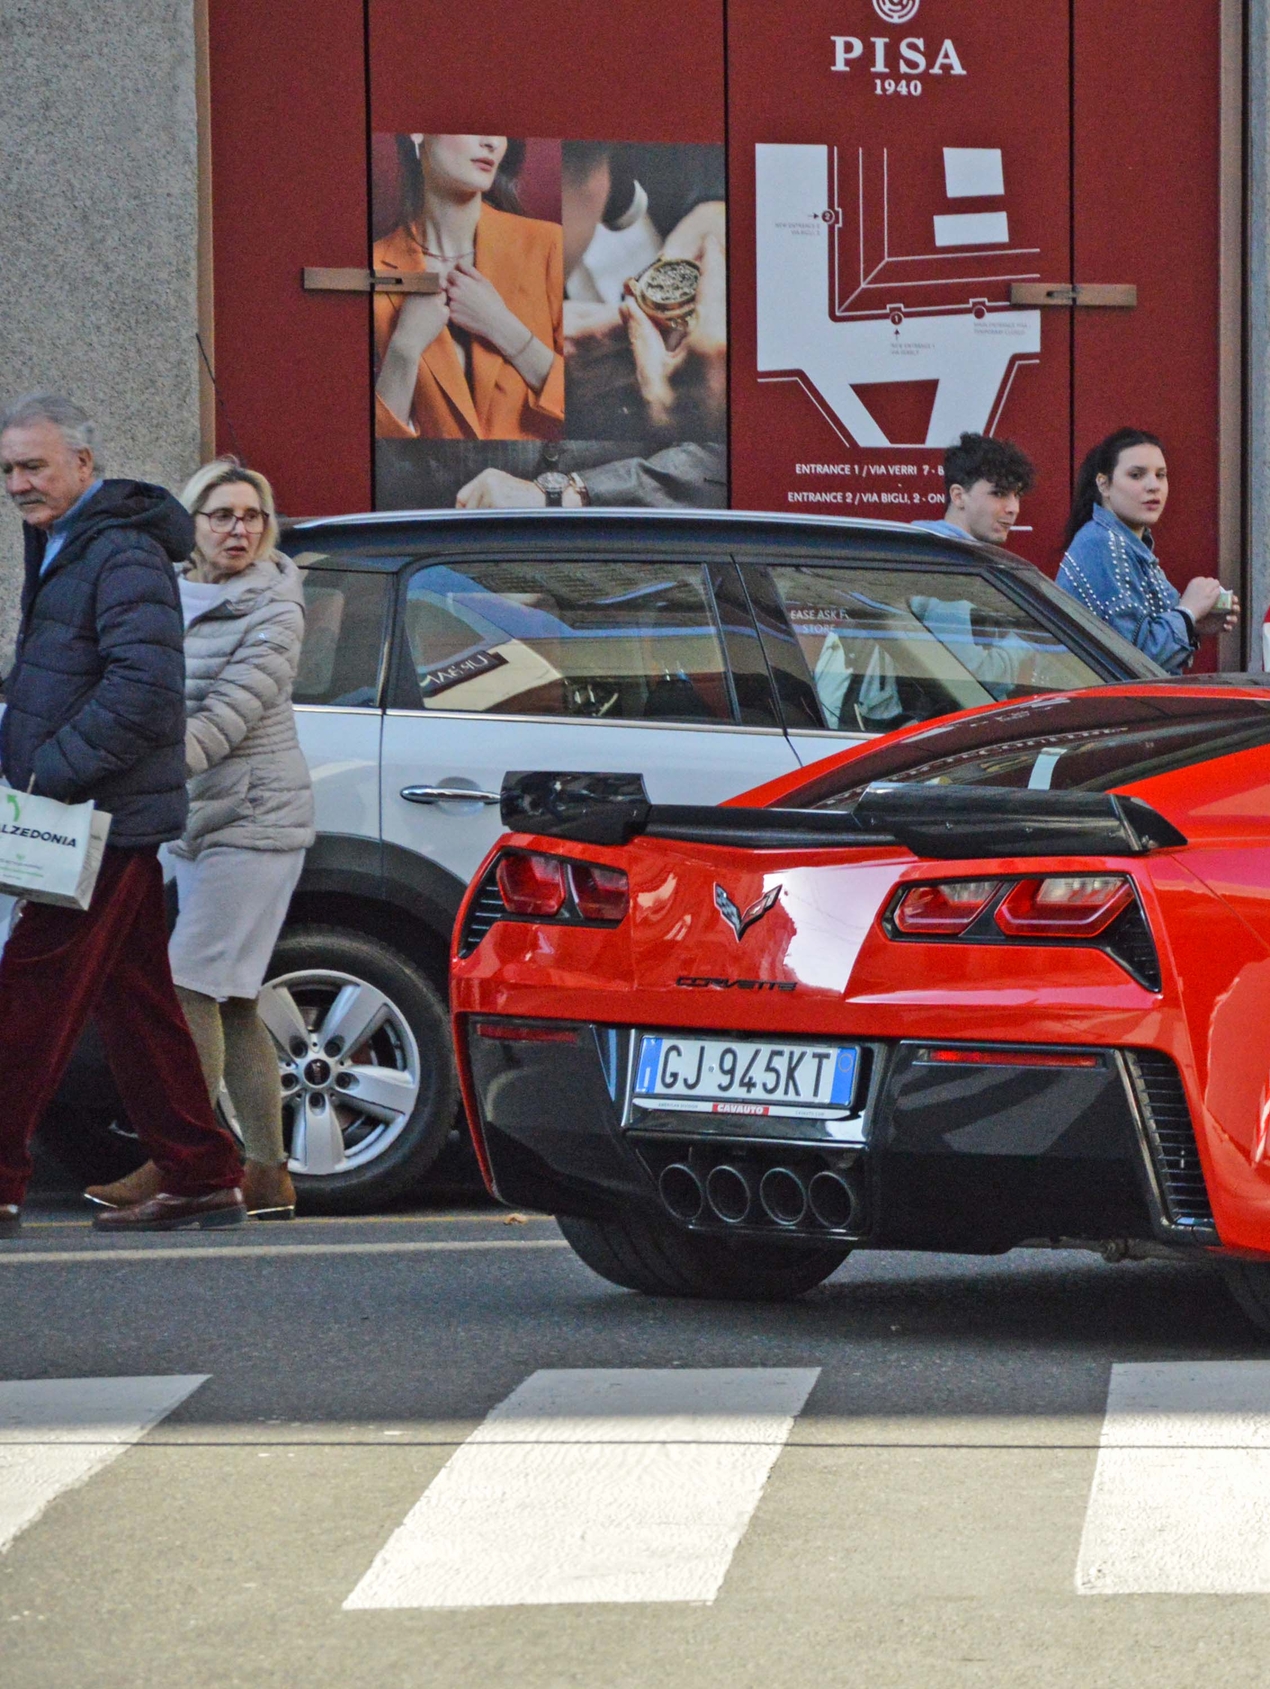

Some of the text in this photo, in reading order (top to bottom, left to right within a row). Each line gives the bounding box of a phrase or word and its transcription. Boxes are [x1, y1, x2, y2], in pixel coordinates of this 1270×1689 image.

[830, 35, 967, 75] PISA
[874, 78, 922, 96] 1940
[795, 463, 851, 475] ENTRANCE
[854, 465, 860, 475] 1
[869, 465, 887, 475] VIA
[888, 465, 917, 476] VERRI
[787, 491, 843, 503] ENTRANCE
[845, 492, 853, 503] 2
[861, 493, 879, 503] VIA
[881, 493, 911, 505] BIGLI,
[913, 493, 920, 504] 2
[0, 824, 77, 847] LZEDONIA
[676, 976, 798, 992] CORVETTE
[717, 1104, 764, 1115] CAVAUTO
